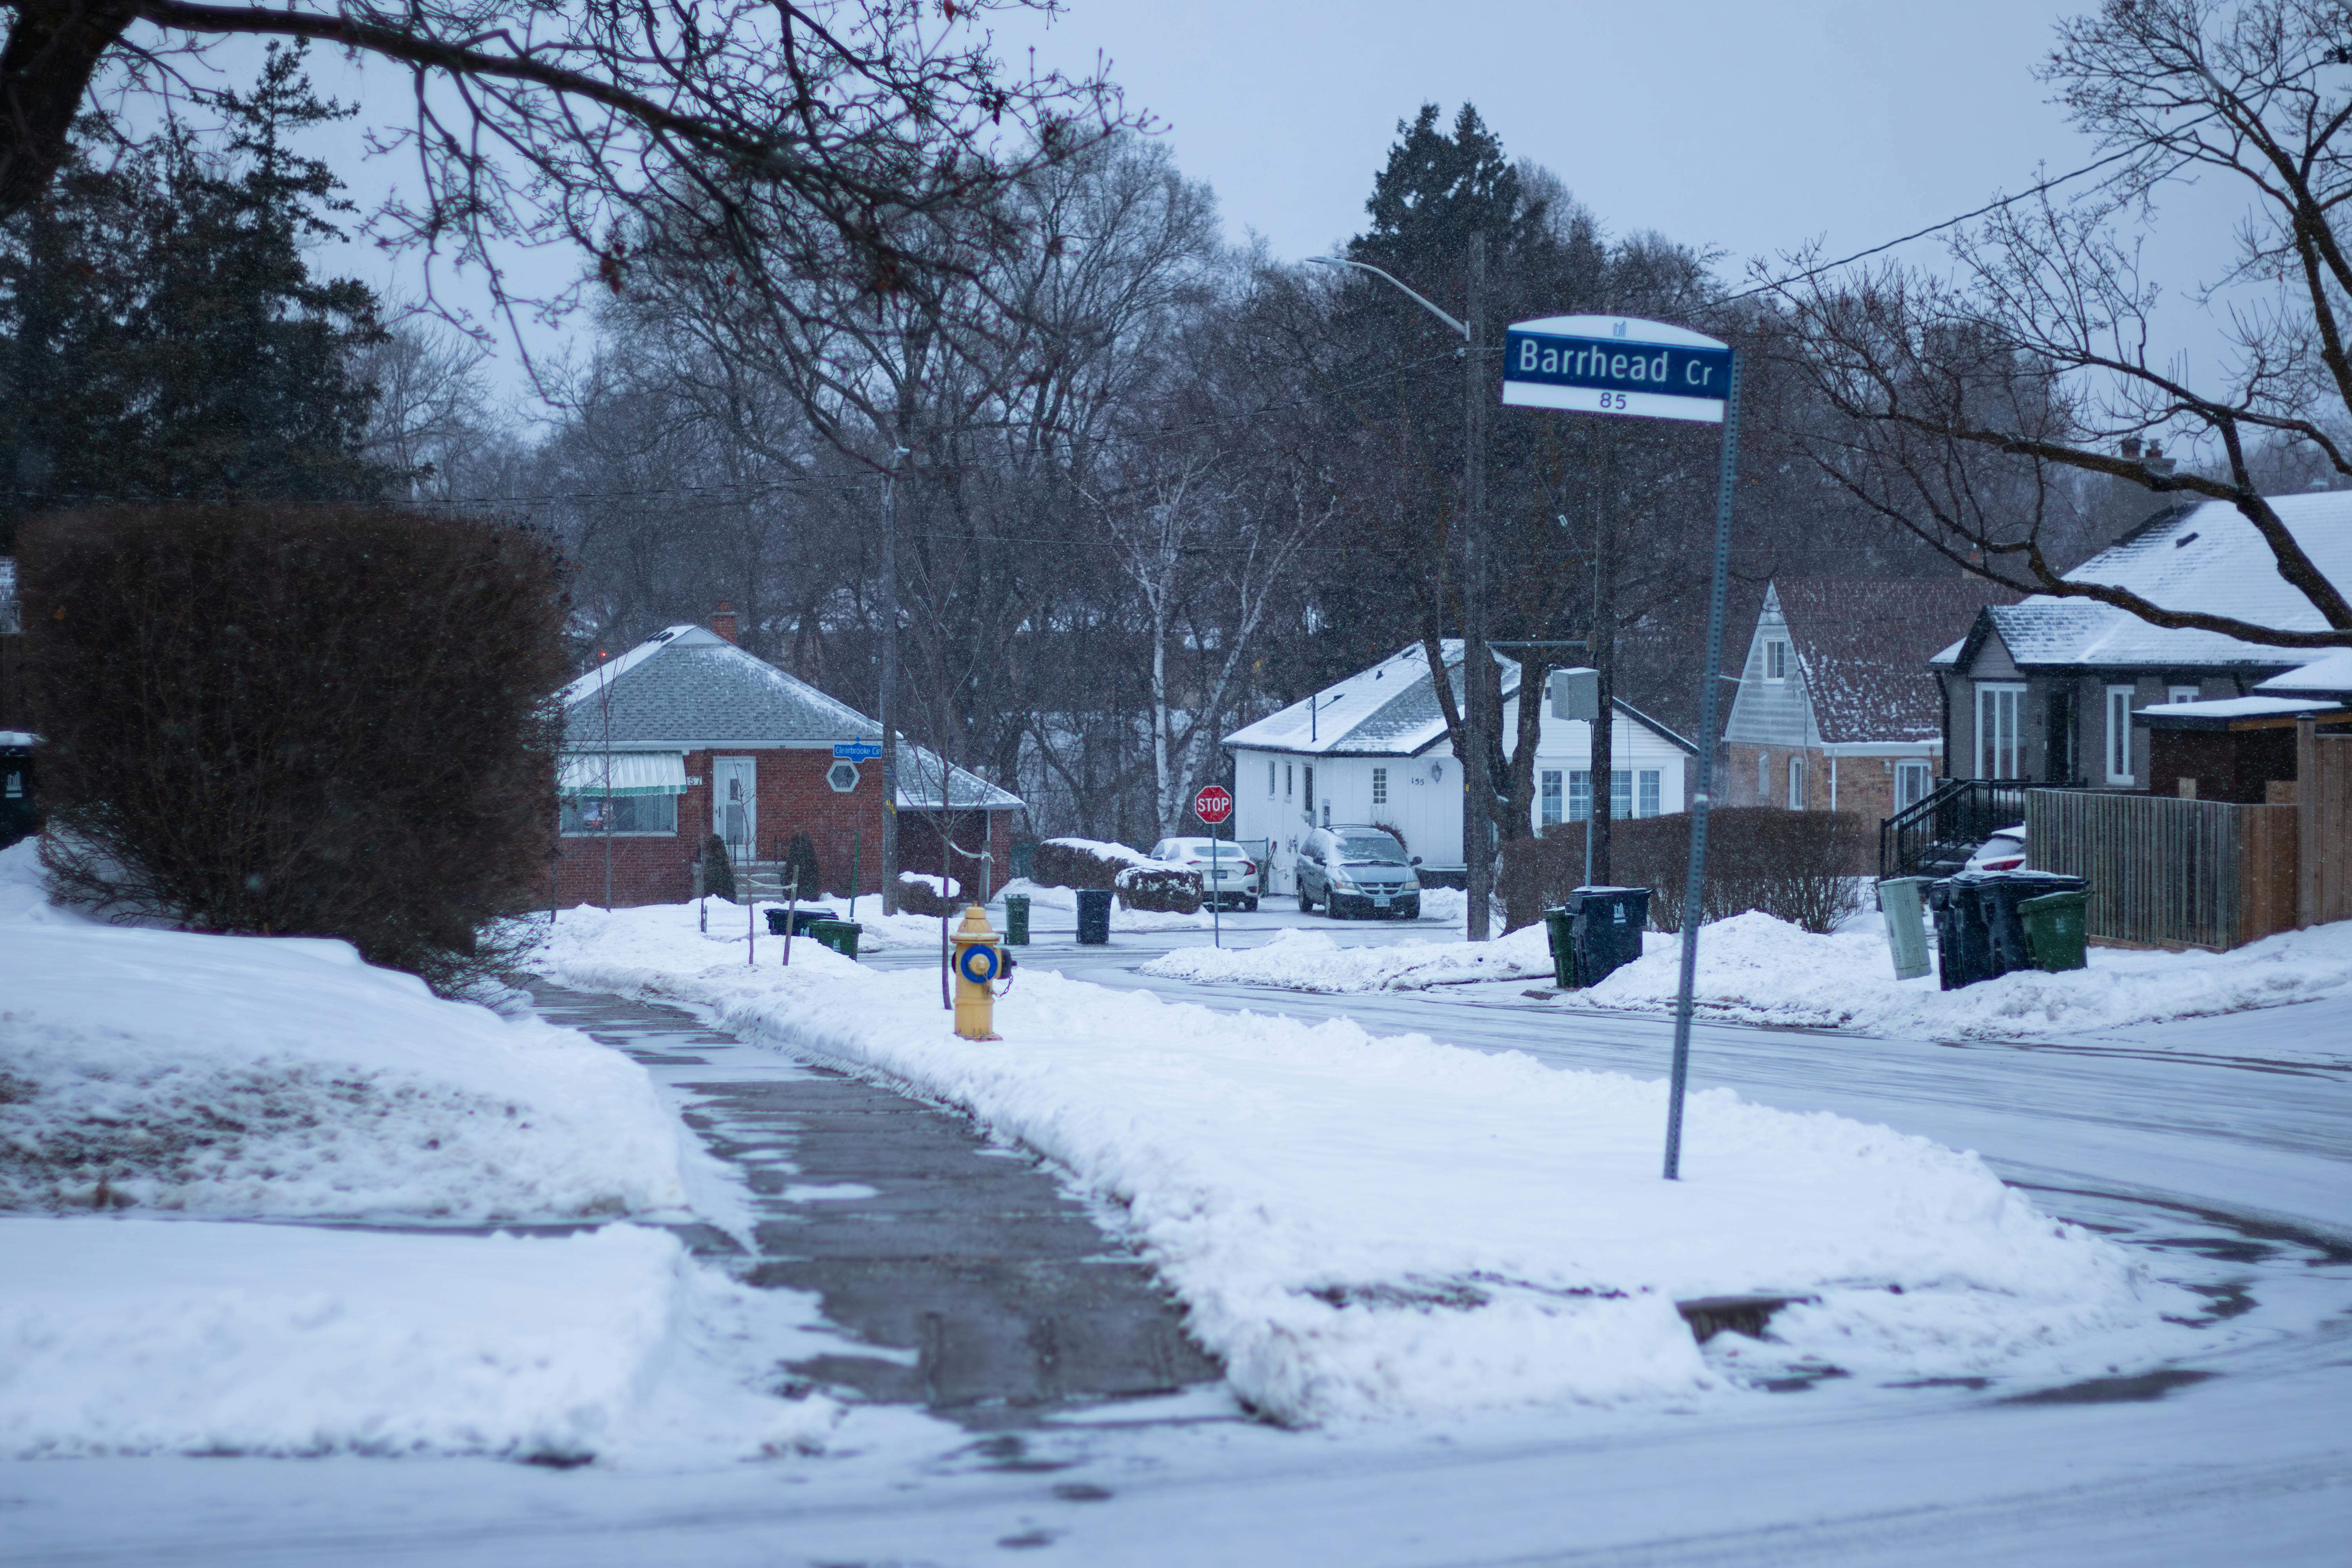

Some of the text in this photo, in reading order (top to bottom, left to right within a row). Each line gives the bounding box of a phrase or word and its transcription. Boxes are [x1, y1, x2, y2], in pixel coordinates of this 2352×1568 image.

[1519, 339, 1713, 386] Barrhead Cr
[1600, 392, 1627, 410] 85
[1412, 777, 1425, 786] 155
[1198, 797, 1229, 812] STOP
